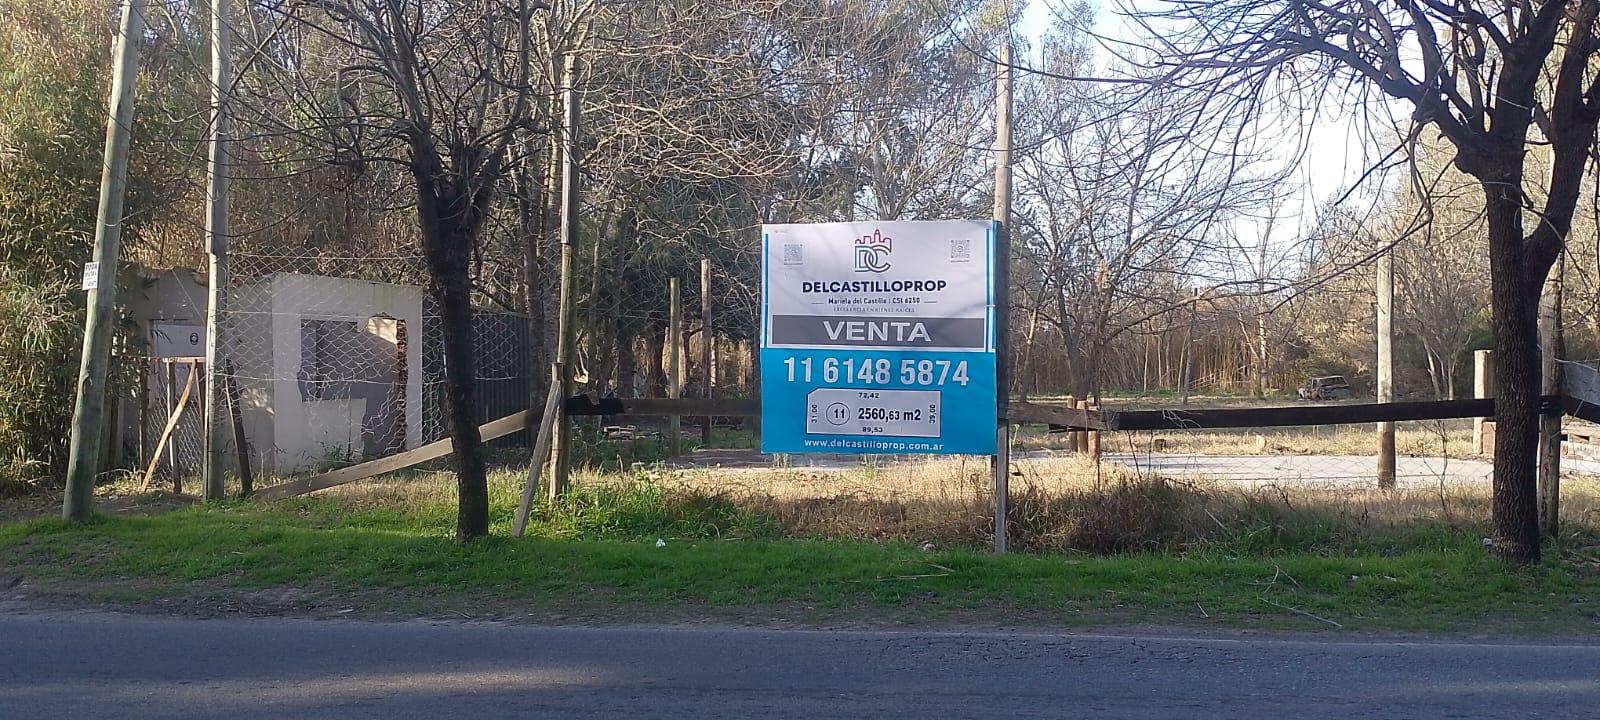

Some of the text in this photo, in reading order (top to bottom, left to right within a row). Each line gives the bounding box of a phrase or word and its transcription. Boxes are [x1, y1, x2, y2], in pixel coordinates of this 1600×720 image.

[802, 280, 947, 293] DELCASTILLOPROP
[828, 297, 851, 305] Mariela
[852, 297, 863, 305] del
[864, 297, 887, 305] Castillo
[823, 320, 932, 342] VENTA
[784, 357, 970, 386] 11 6148 5874
[834, 408, 846, 419] 11
[858, 408, 921, 423] 2560,63 m2
[804, 438, 944, 451] www.delcastilloprop.com.ar
